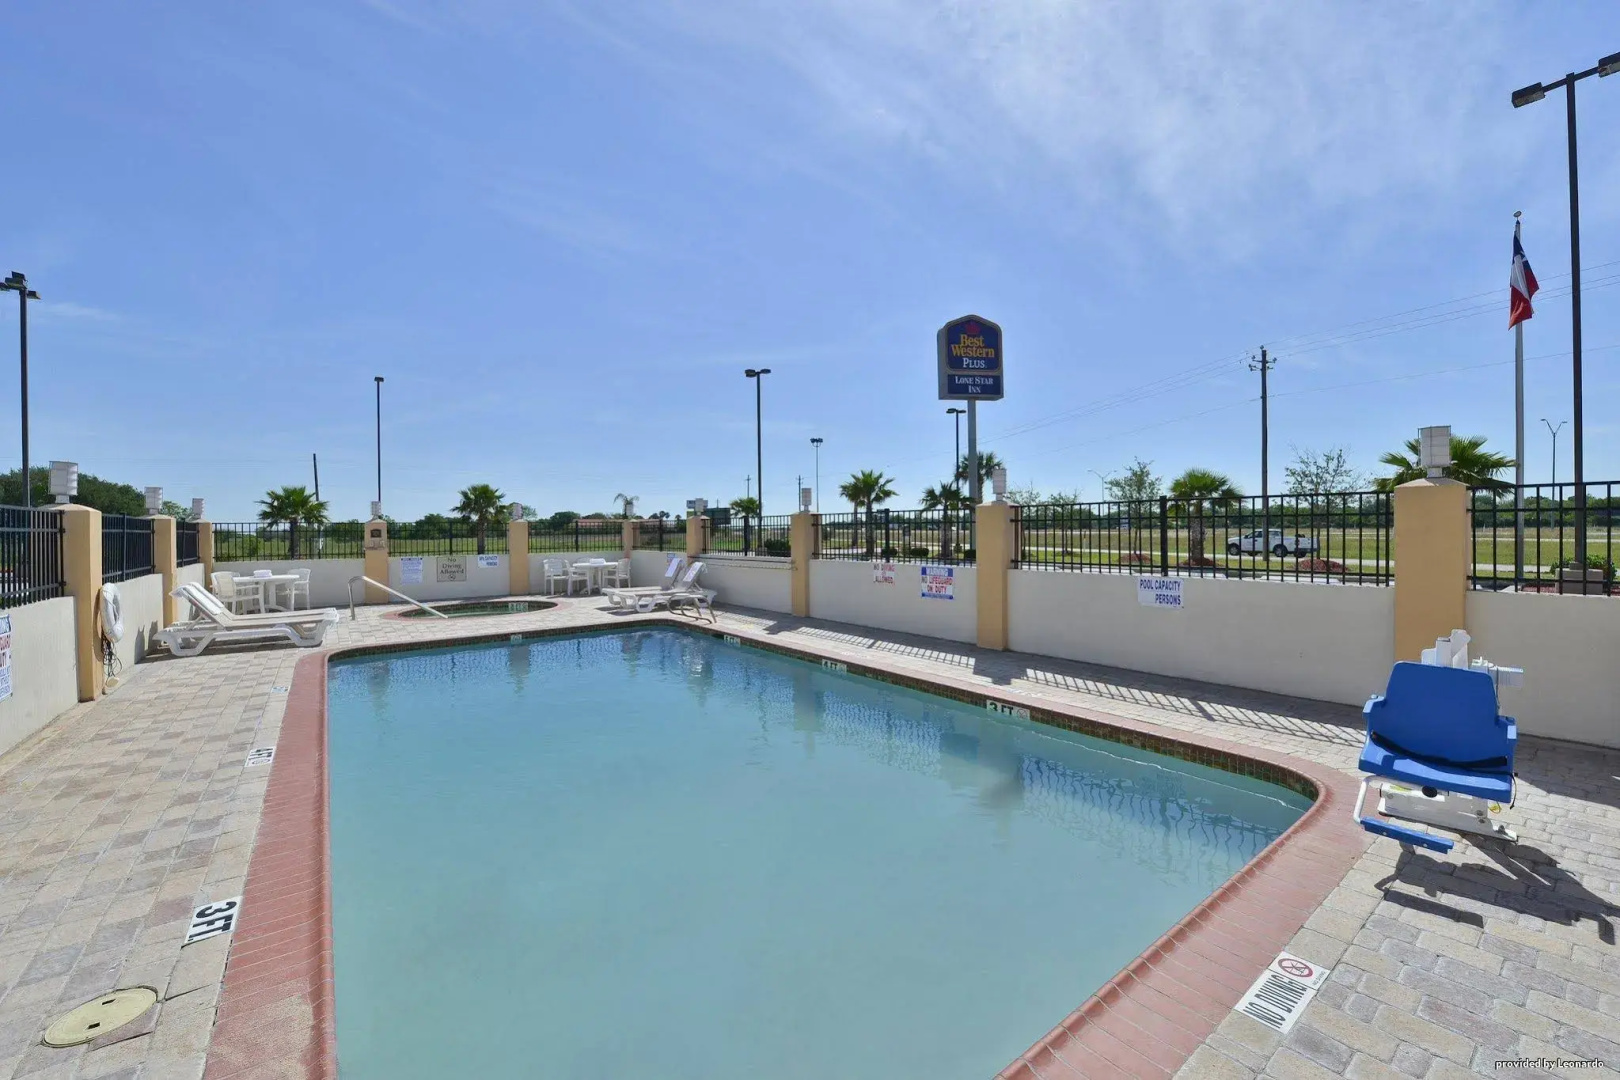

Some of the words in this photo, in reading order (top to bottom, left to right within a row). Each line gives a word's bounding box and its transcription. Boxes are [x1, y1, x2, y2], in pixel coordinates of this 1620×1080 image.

[960, 334, 985, 347] Best
[951, 344, 995, 358] Western
[962, 357, 986, 369] PLUS
[955, 376, 974, 385] LONE
[975, 376, 994, 385] STAR
[968, 385, 982, 394] INN
[926, 567, 948, 577] WARNING
[929, 577, 953, 586] LIFEGUARD
[1140, 579, 1154, 590] POOL
[1155, 580, 1181, 591] CAPACITY
[927, 585, 933, 593] ON
[935, 586, 947, 594] DUTY
[1155, 594, 1181, 606] PERSONS
[990, 702, 998, 712] 3
[1001, 704, 1014, 715] FT
[1254, 974, 1308, 1014] DIVING
[1243, 1001, 1286, 1029] NO
